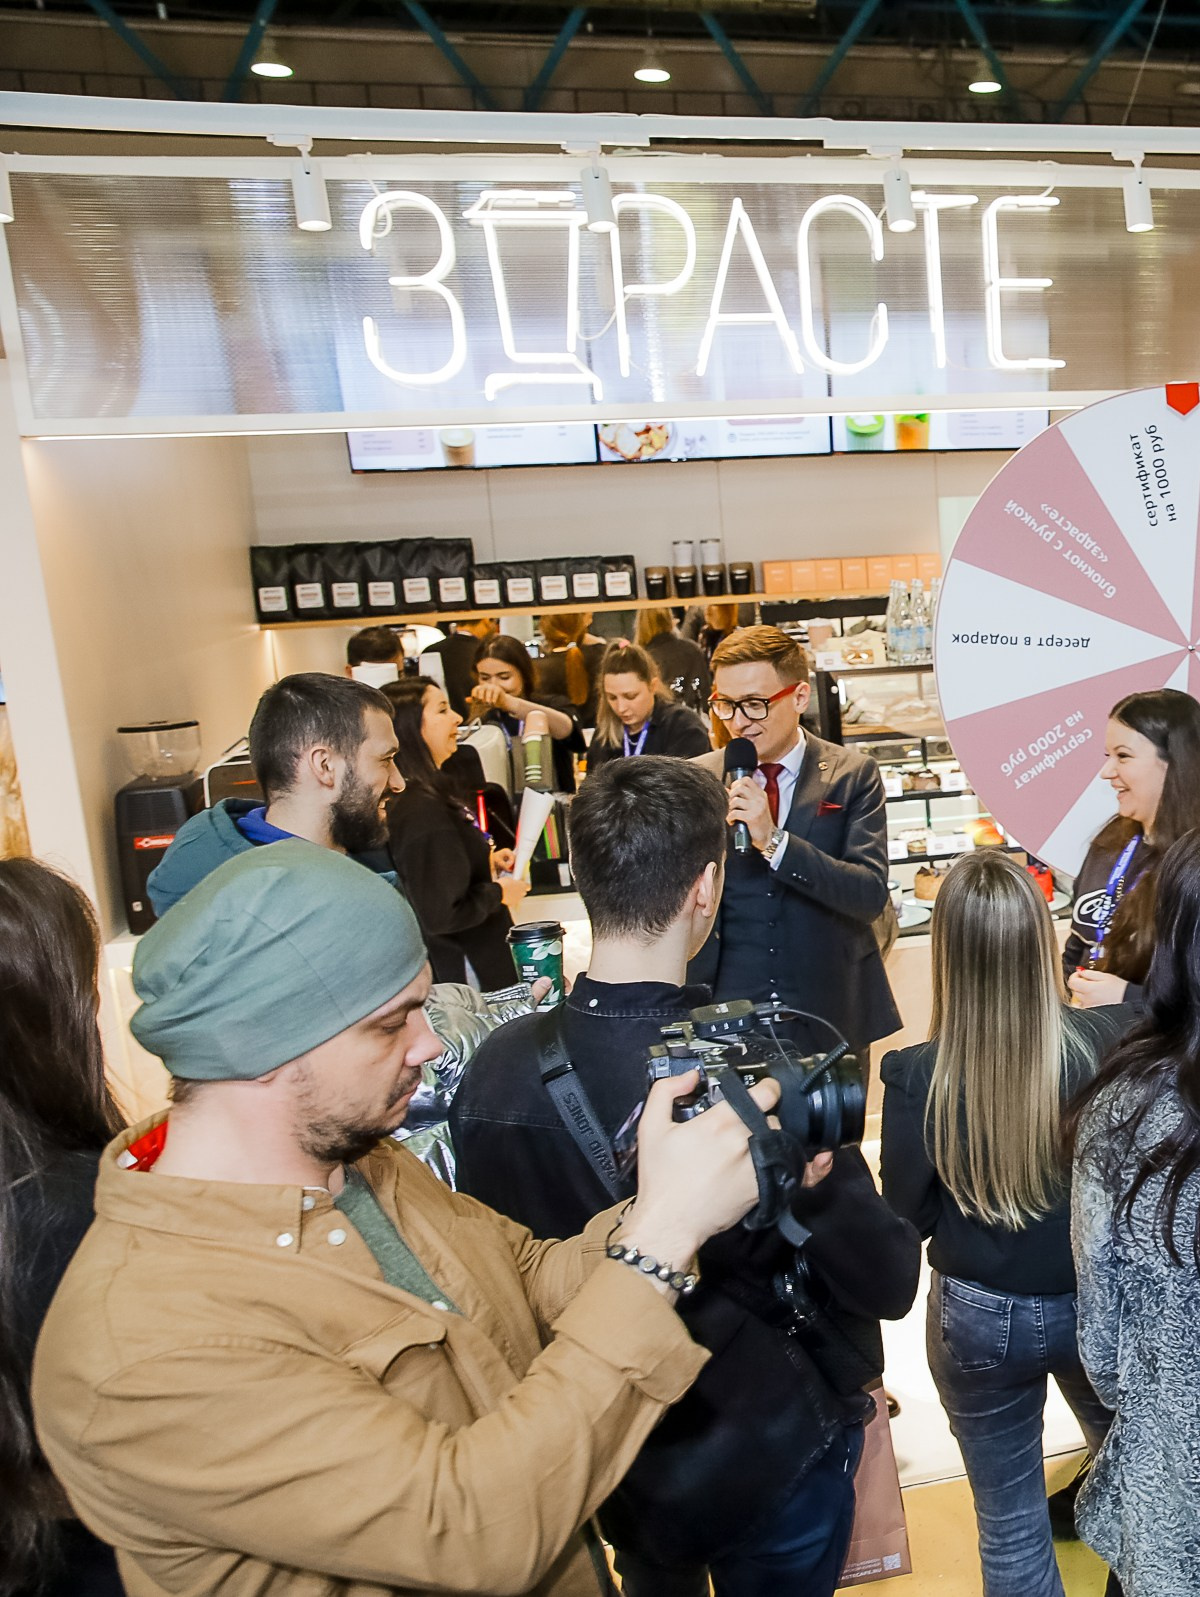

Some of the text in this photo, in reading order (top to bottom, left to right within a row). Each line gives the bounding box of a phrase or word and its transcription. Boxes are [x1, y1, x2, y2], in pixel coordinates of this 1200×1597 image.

[1129, 433, 1158, 527] сертификат
[1145, 424, 1177, 522] на 1000 руб
[1003, 499, 1117, 598] блокнот с ручкой
[1040, 503, 1109, 563] «здрасте»
[951, 633, 1091, 649] десерт в подарок
[1000, 710, 1084, 777] на 2000 руб
[1013, 727, 1093, 790] сертификат
